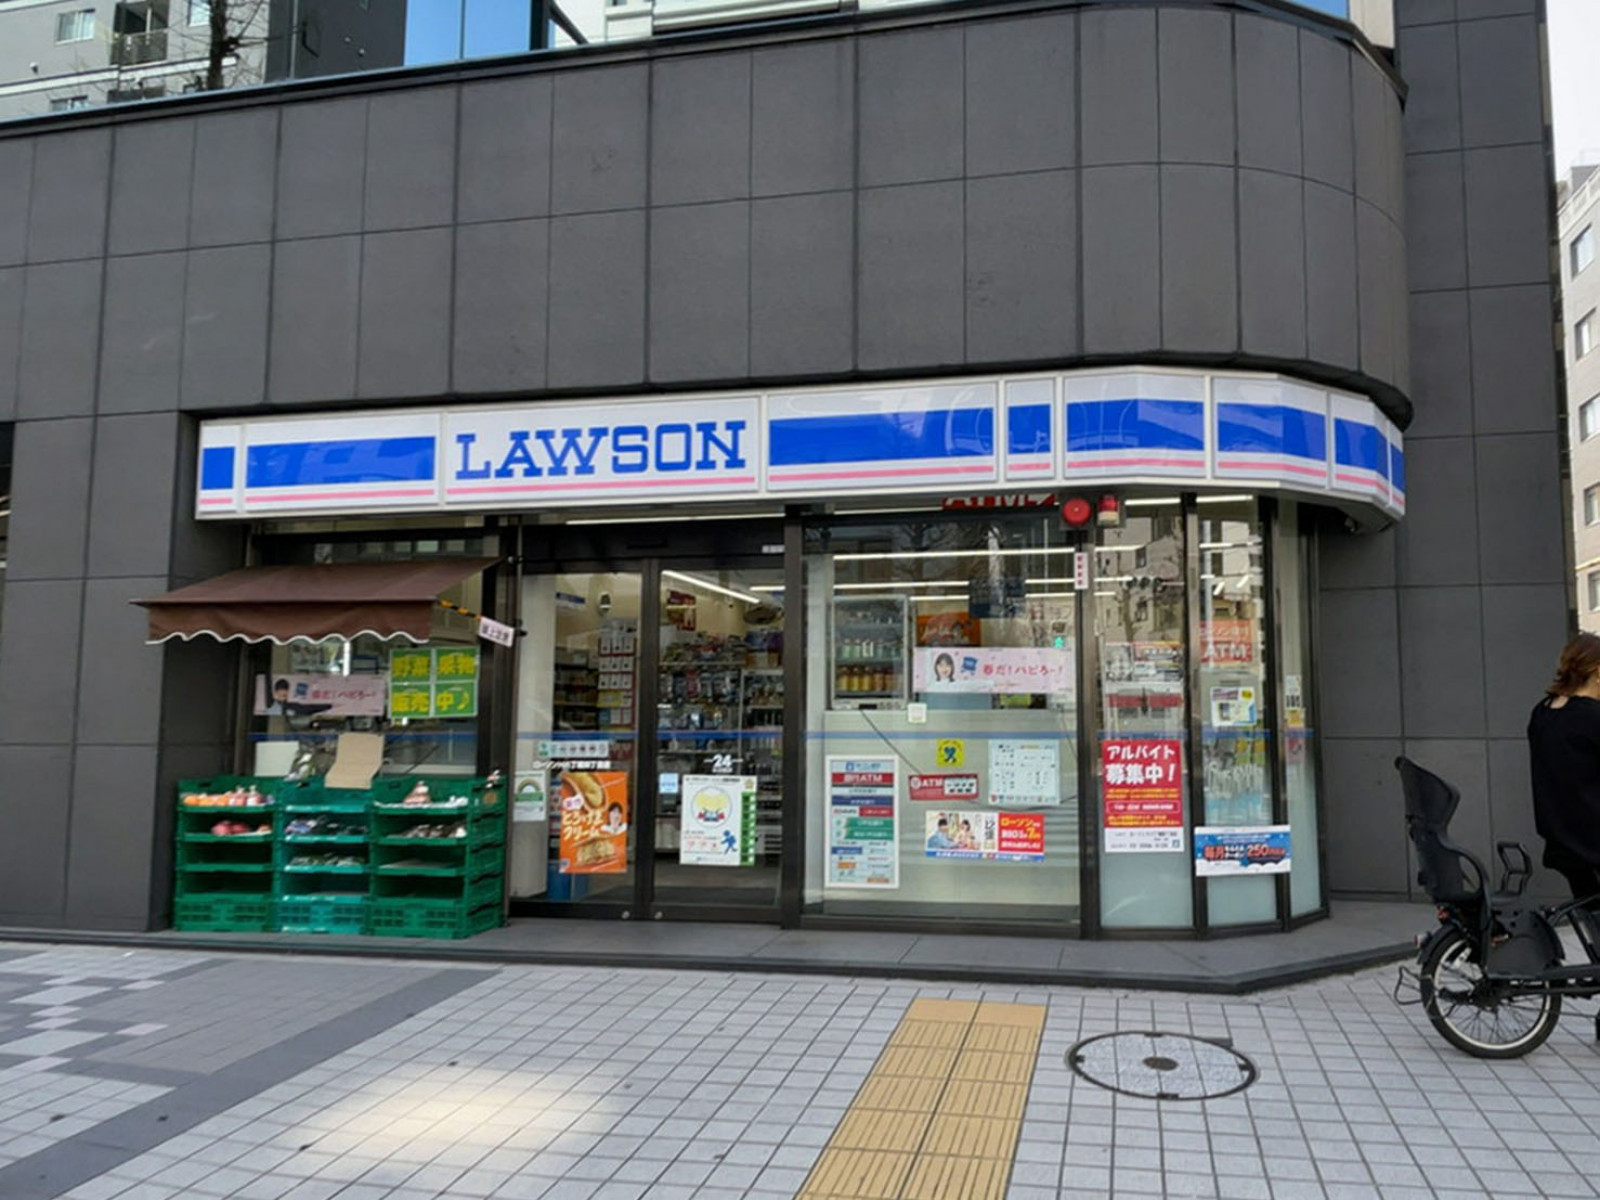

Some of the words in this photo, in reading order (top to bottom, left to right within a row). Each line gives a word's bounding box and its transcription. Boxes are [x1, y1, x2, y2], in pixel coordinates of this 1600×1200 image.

[456, 420, 747, 480] LAWSON
[1204, 643, 1247, 660] ATM
[1107, 745, 1176, 760] アルバイト
[712, 754, 732, 768] 24
[1105, 763, 1176, 786] 募集中!
[922, 778, 944, 788] ATM
